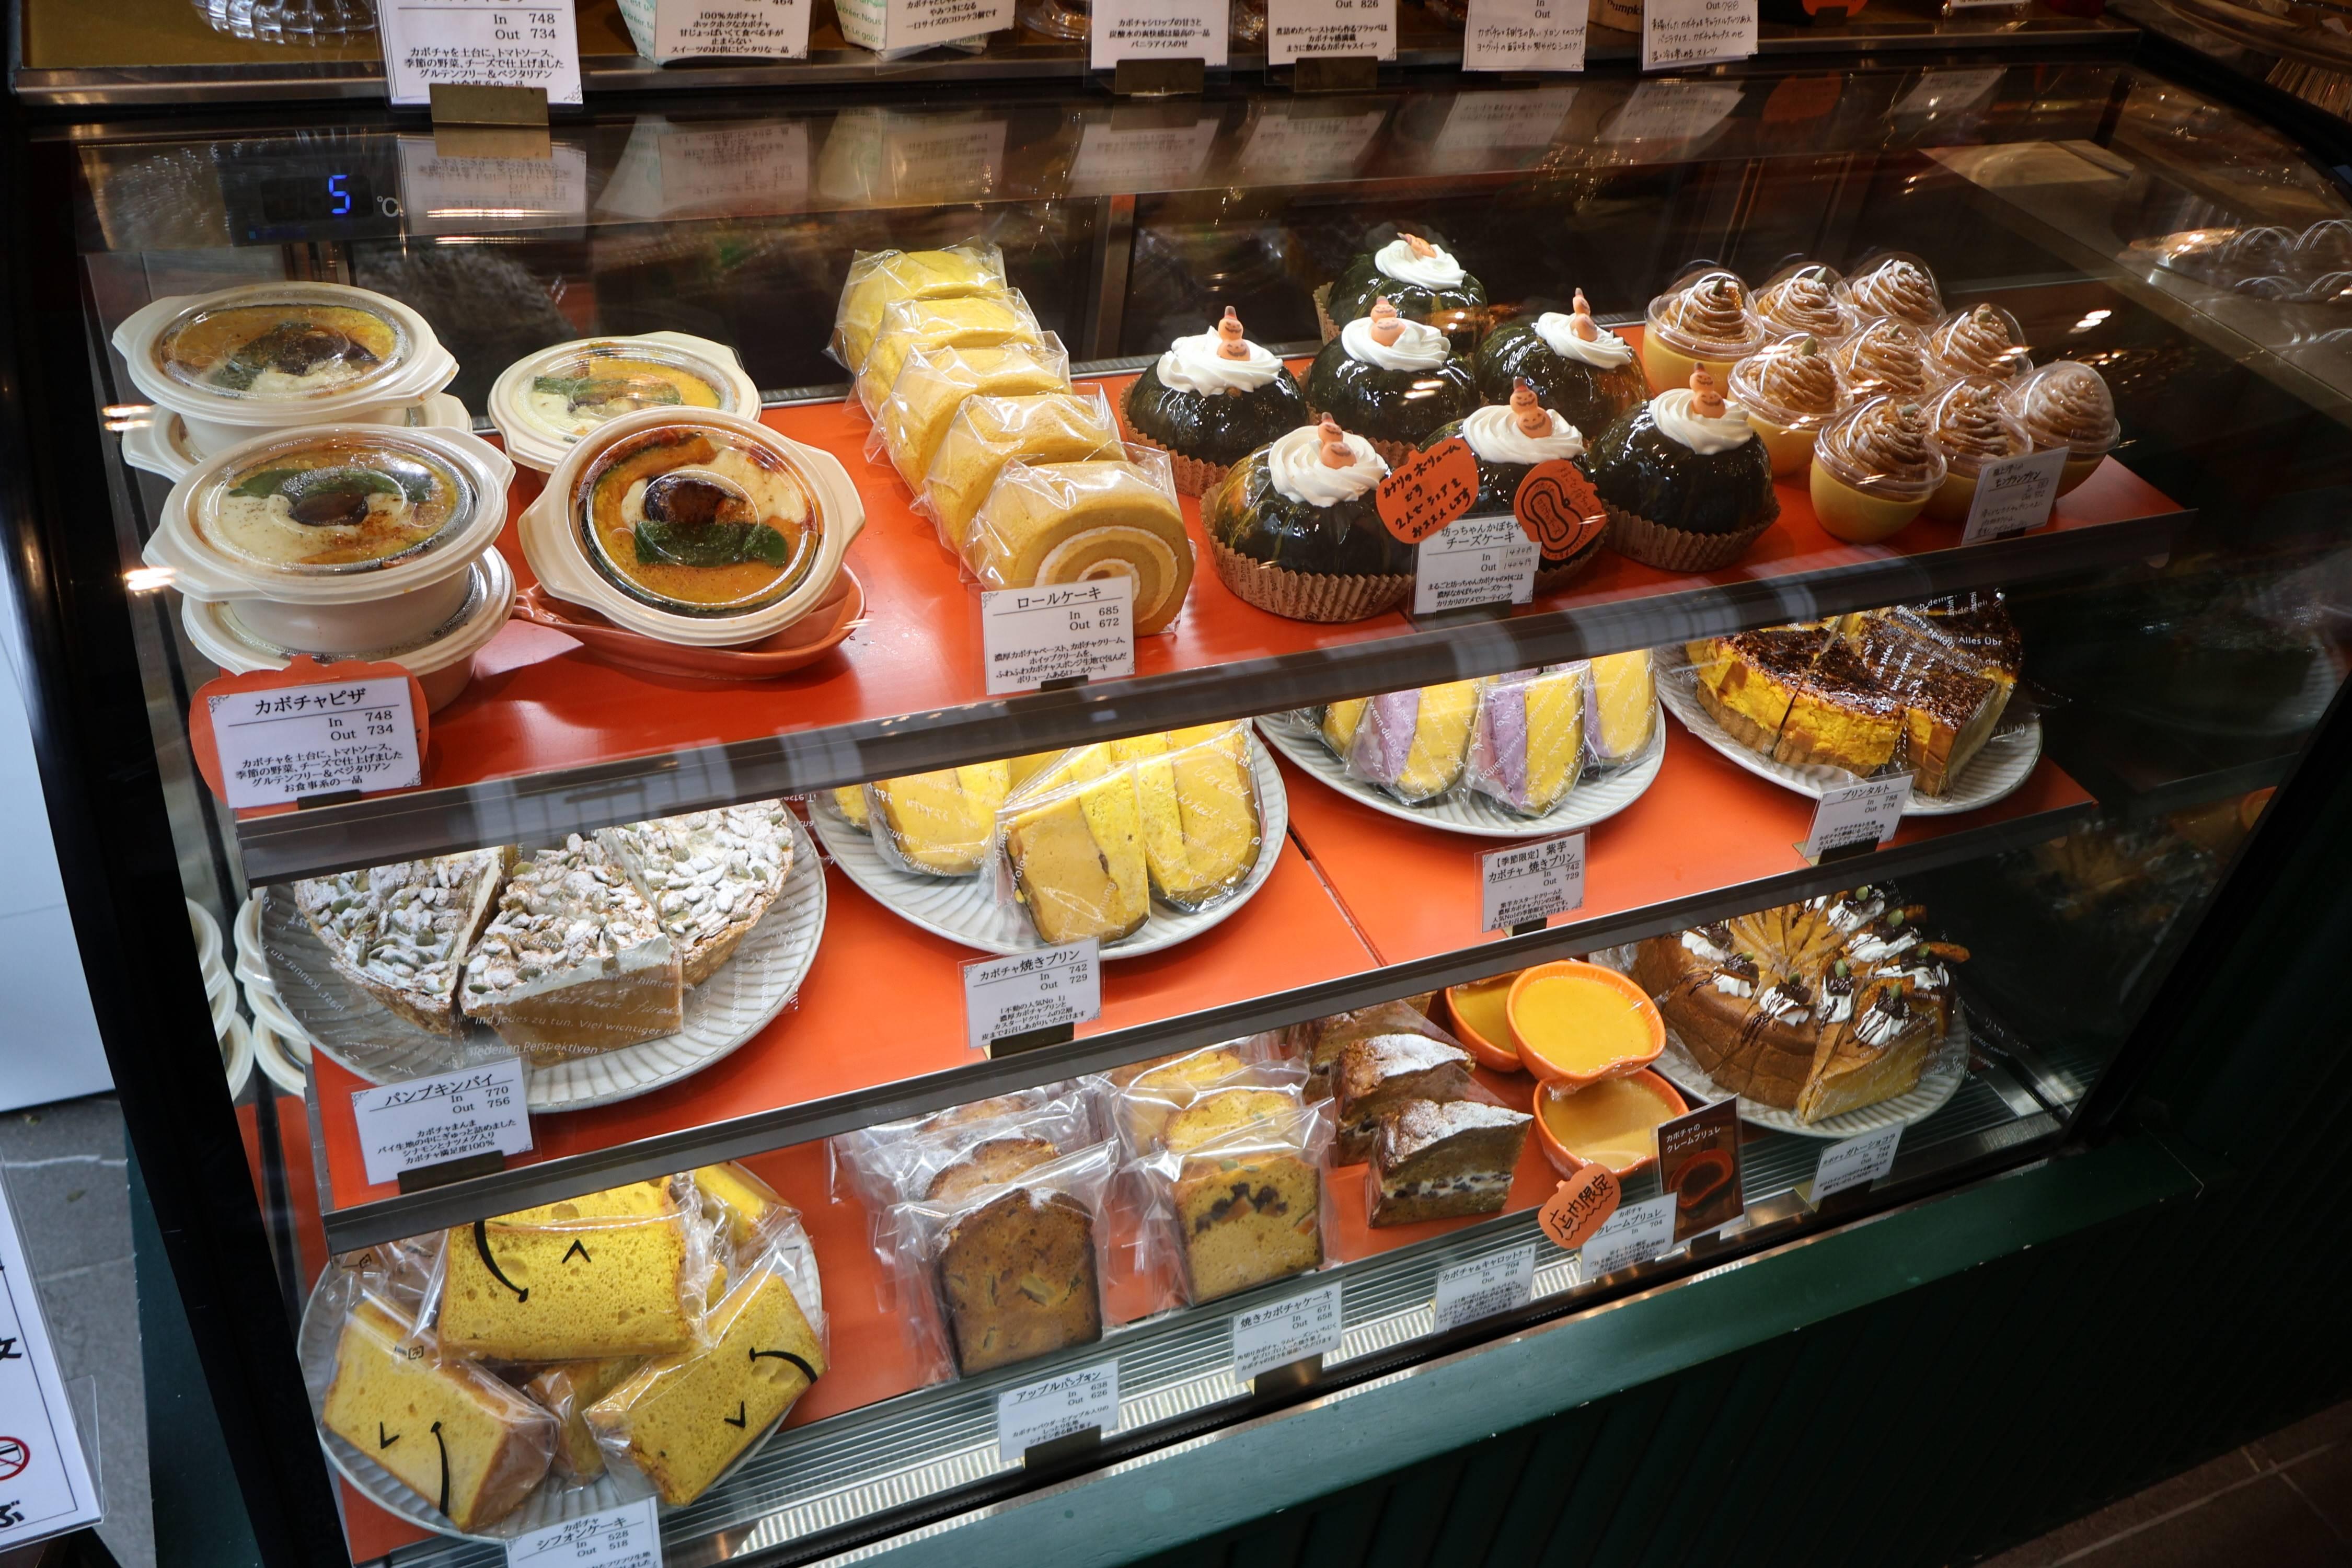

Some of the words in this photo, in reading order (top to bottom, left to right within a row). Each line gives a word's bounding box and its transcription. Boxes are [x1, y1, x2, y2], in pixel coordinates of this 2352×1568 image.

[1335, 0, 1353, 9] Out
[1361, 0, 1379, 9] 826
[1706, 2, 1720, 10] Out
[494, 14, 507, 24] In
[529, 14, 556, 24] 748
[1535, 10, 1551, 19] Out
[495, 30, 521, 40] Out
[531, 29, 556, 39] 734
[328, 174, 351, 214] 5
[1446, 531, 1516, 549] チーズケーキ
[1482, 553, 1491, 561] In
[1017, 586, 1102, 609] ロールケーキ
[1069, 611, 1081, 620] In
[1099, 605, 1120, 616] 685
[1069, 620, 1091, 631] Out
[1099, 618, 1120, 628] 672
[1958, 636, 1981, 645] Alles
[255, 687, 367, 716] カボチャピザ
[329, 718, 343, 728] In
[365, 710, 393, 722] 748
[330, 730, 358, 742] Out
[366, 724, 394, 736] 734
[1413, 733, 1431, 758] sofort
[284, 775, 363, 793] お食事系の一品
[1841, 784, 1890, 801] プリンタルト
[1885, 794, 1899, 802] 788
[1496, 848, 1540, 869] 【季節限定】
[1546, 840, 1568, 856] 紫芋
[1489, 867, 1524, 883] カボチャ
[1528, 852, 1576, 874] 焼きプリン
[1565, 862, 1580, 872] 742
[1543, 879, 1558, 887] Out
[1565, 871, 1579, 881] 729
[979, 950, 1081, 982] カボチャ焼きプリン
[1040, 973, 1050, 981] In
[1068, 963, 1088, 974] 742
[1040, 982, 1058, 991] Out
[1069, 973, 1088, 984] 729
[523, 1041, 598, 1055] Perspektiven
[385, 1073, 493, 1106] パンプキンパイ
[451, 1094, 463, 1103] In
[485, 1086, 509, 1097] 770
[452, 1103, 475, 1114] Out
[487, 1097, 511, 1109] 756
[416, 1120, 477, 1138] カボチャまんま
[1666, 1123, 1701, 1144] カボチャの
[1667, 1125, 1722, 1154] クレームブリュレ
[1550, 1173, 1615, 1239] 店内限定
[1650, 1219, 1663, 1228] 704
[1240, 1289, 1334, 1329] 焼きカボチャケーキ
[1317, 1304, 1332, 1314] 671
[1292, 1320, 1308, 1330] Out
[1317, 1312, 1333, 1322] 658
[1016, 1371, 1102, 1403] アップルパンプキン
[1090, 1381, 1109, 1391] 638
[1067, 1397, 1084, 1406] Out
[1090, 1389, 1108, 1399] 626
[563, 1517, 599, 1533] カボチャ
[536, 1517, 627, 1551] シフォンケーキ
[607, 1529, 629, 1541] 528
[577, 1547, 597, 1558] Out
[608, 1541, 630, 1551] 518
